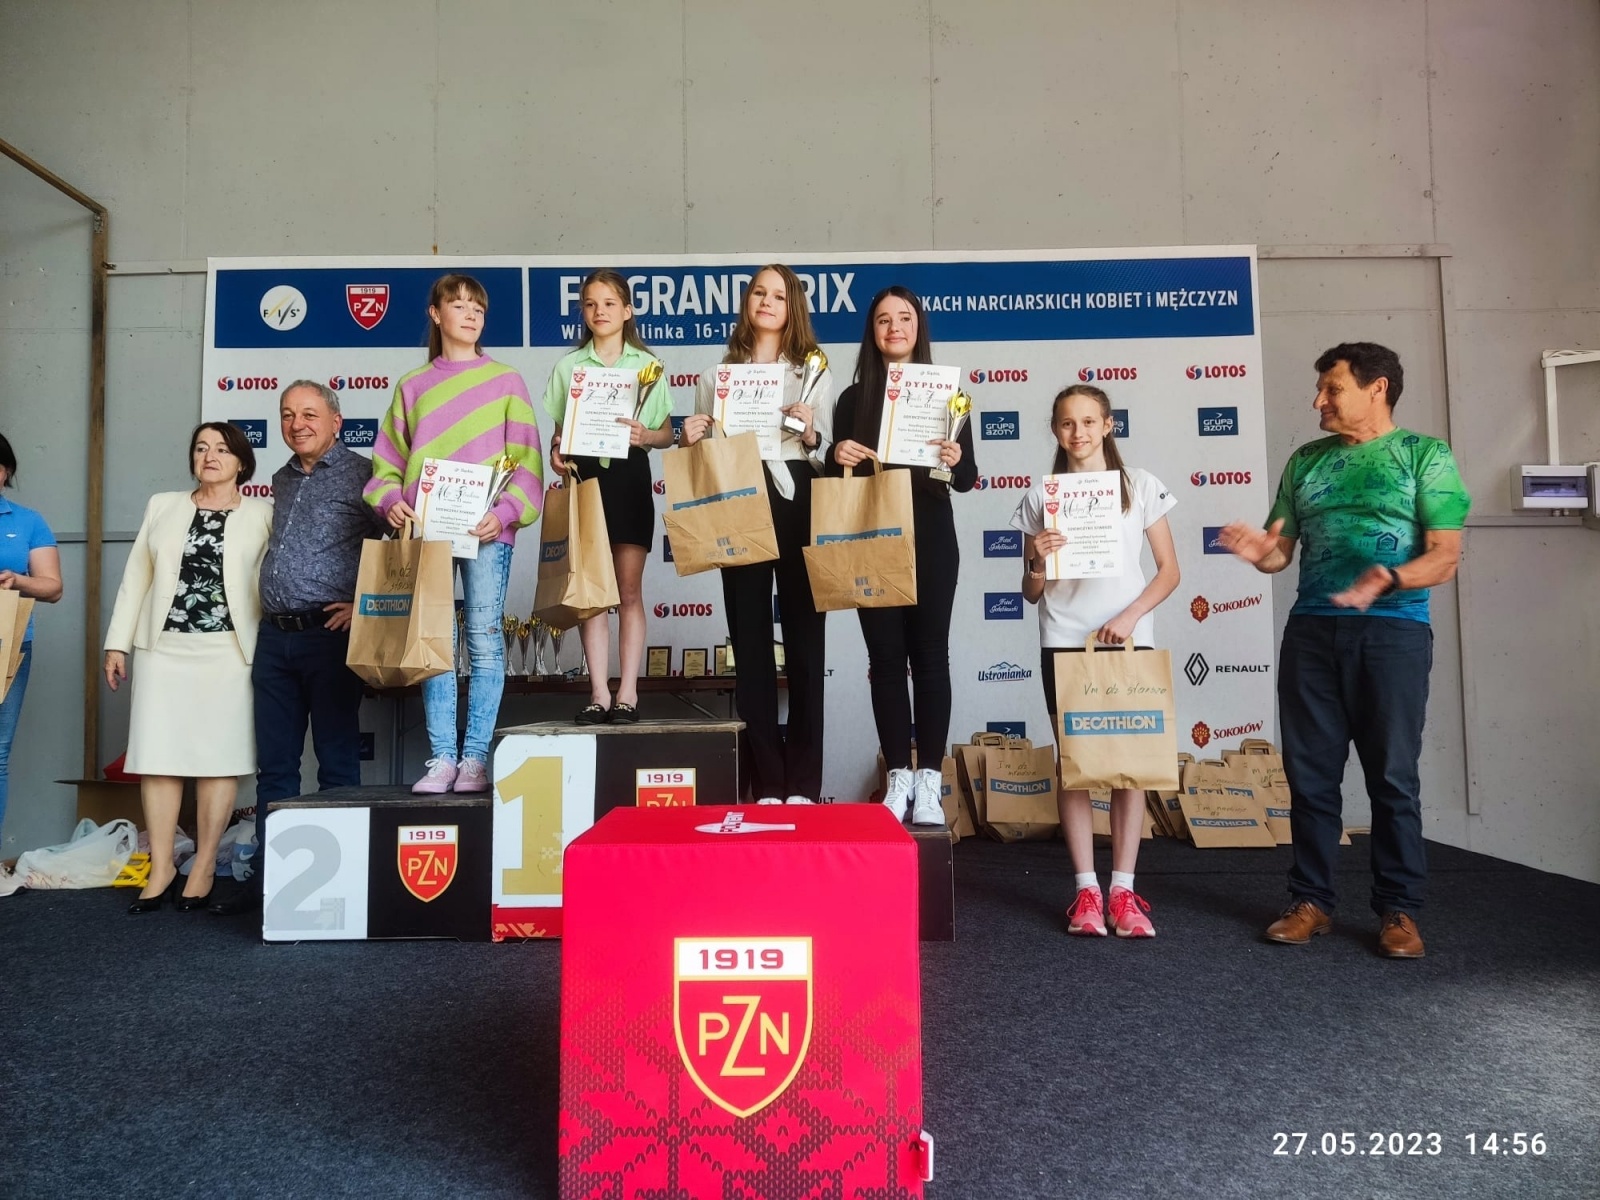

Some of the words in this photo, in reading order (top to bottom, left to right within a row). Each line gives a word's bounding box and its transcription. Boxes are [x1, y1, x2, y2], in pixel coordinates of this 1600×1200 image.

[798, 272, 857, 313] RIX
[917, 295, 962, 312] KACH
[966, 293, 1081, 311] NARCIARSKICH
[1086, 291, 1142, 309] KOBIET
[1146, 291, 1151, 307] i
[1156, 288, 1238, 311] MĘŻCZYZN
[353, 298, 384, 317] PZN
[636, 323, 684, 339] linka
[988, 369, 1028, 383] LOTOS
[1097, 367, 1137, 381] LOTOS
[1205, 365, 1246, 378] LOTOS
[237, 377, 278, 390] LOTOS
[348, 376, 389, 389] LOTOS
[588, 381, 632, 390] DYPLOM
[670, 374, 700, 387] LOTO
[905, 381, 953, 391] DYPLOM
[439, 475, 484, 487] DYPLOM
[991, 476, 1031, 488] LOTOS
[1210, 471, 1251, 485] LOTOS
[236, 485, 274, 497] OTO
[1063, 489, 1114, 499] DYPLOM
[366, 598, 410, 611] DECATHLON
[672, 603, 713, 617] LOTOS
[1212, 593, 1262, 614] SOKOŁÓW
[978, 669, 1032, 682] Ustronianka
[1215, 665, 1270, 673] RENAULT
[1072, 715, 1156, 731] DECATHLON
[1213, 720, 1263, 739] SOKOŁÓW
[647, 773, 684, 783] 1919
[995, 782, 1046, 793] DECATHLON
[495, 756, 563, 894] 1
[408, 830, 446, 840] 1919
[407, 850, 448, 885] PZN
[265, 824, 345, 931] 2
[698, 948, 785, 970] 1919
[698, 995, 789, 1077] PZN
